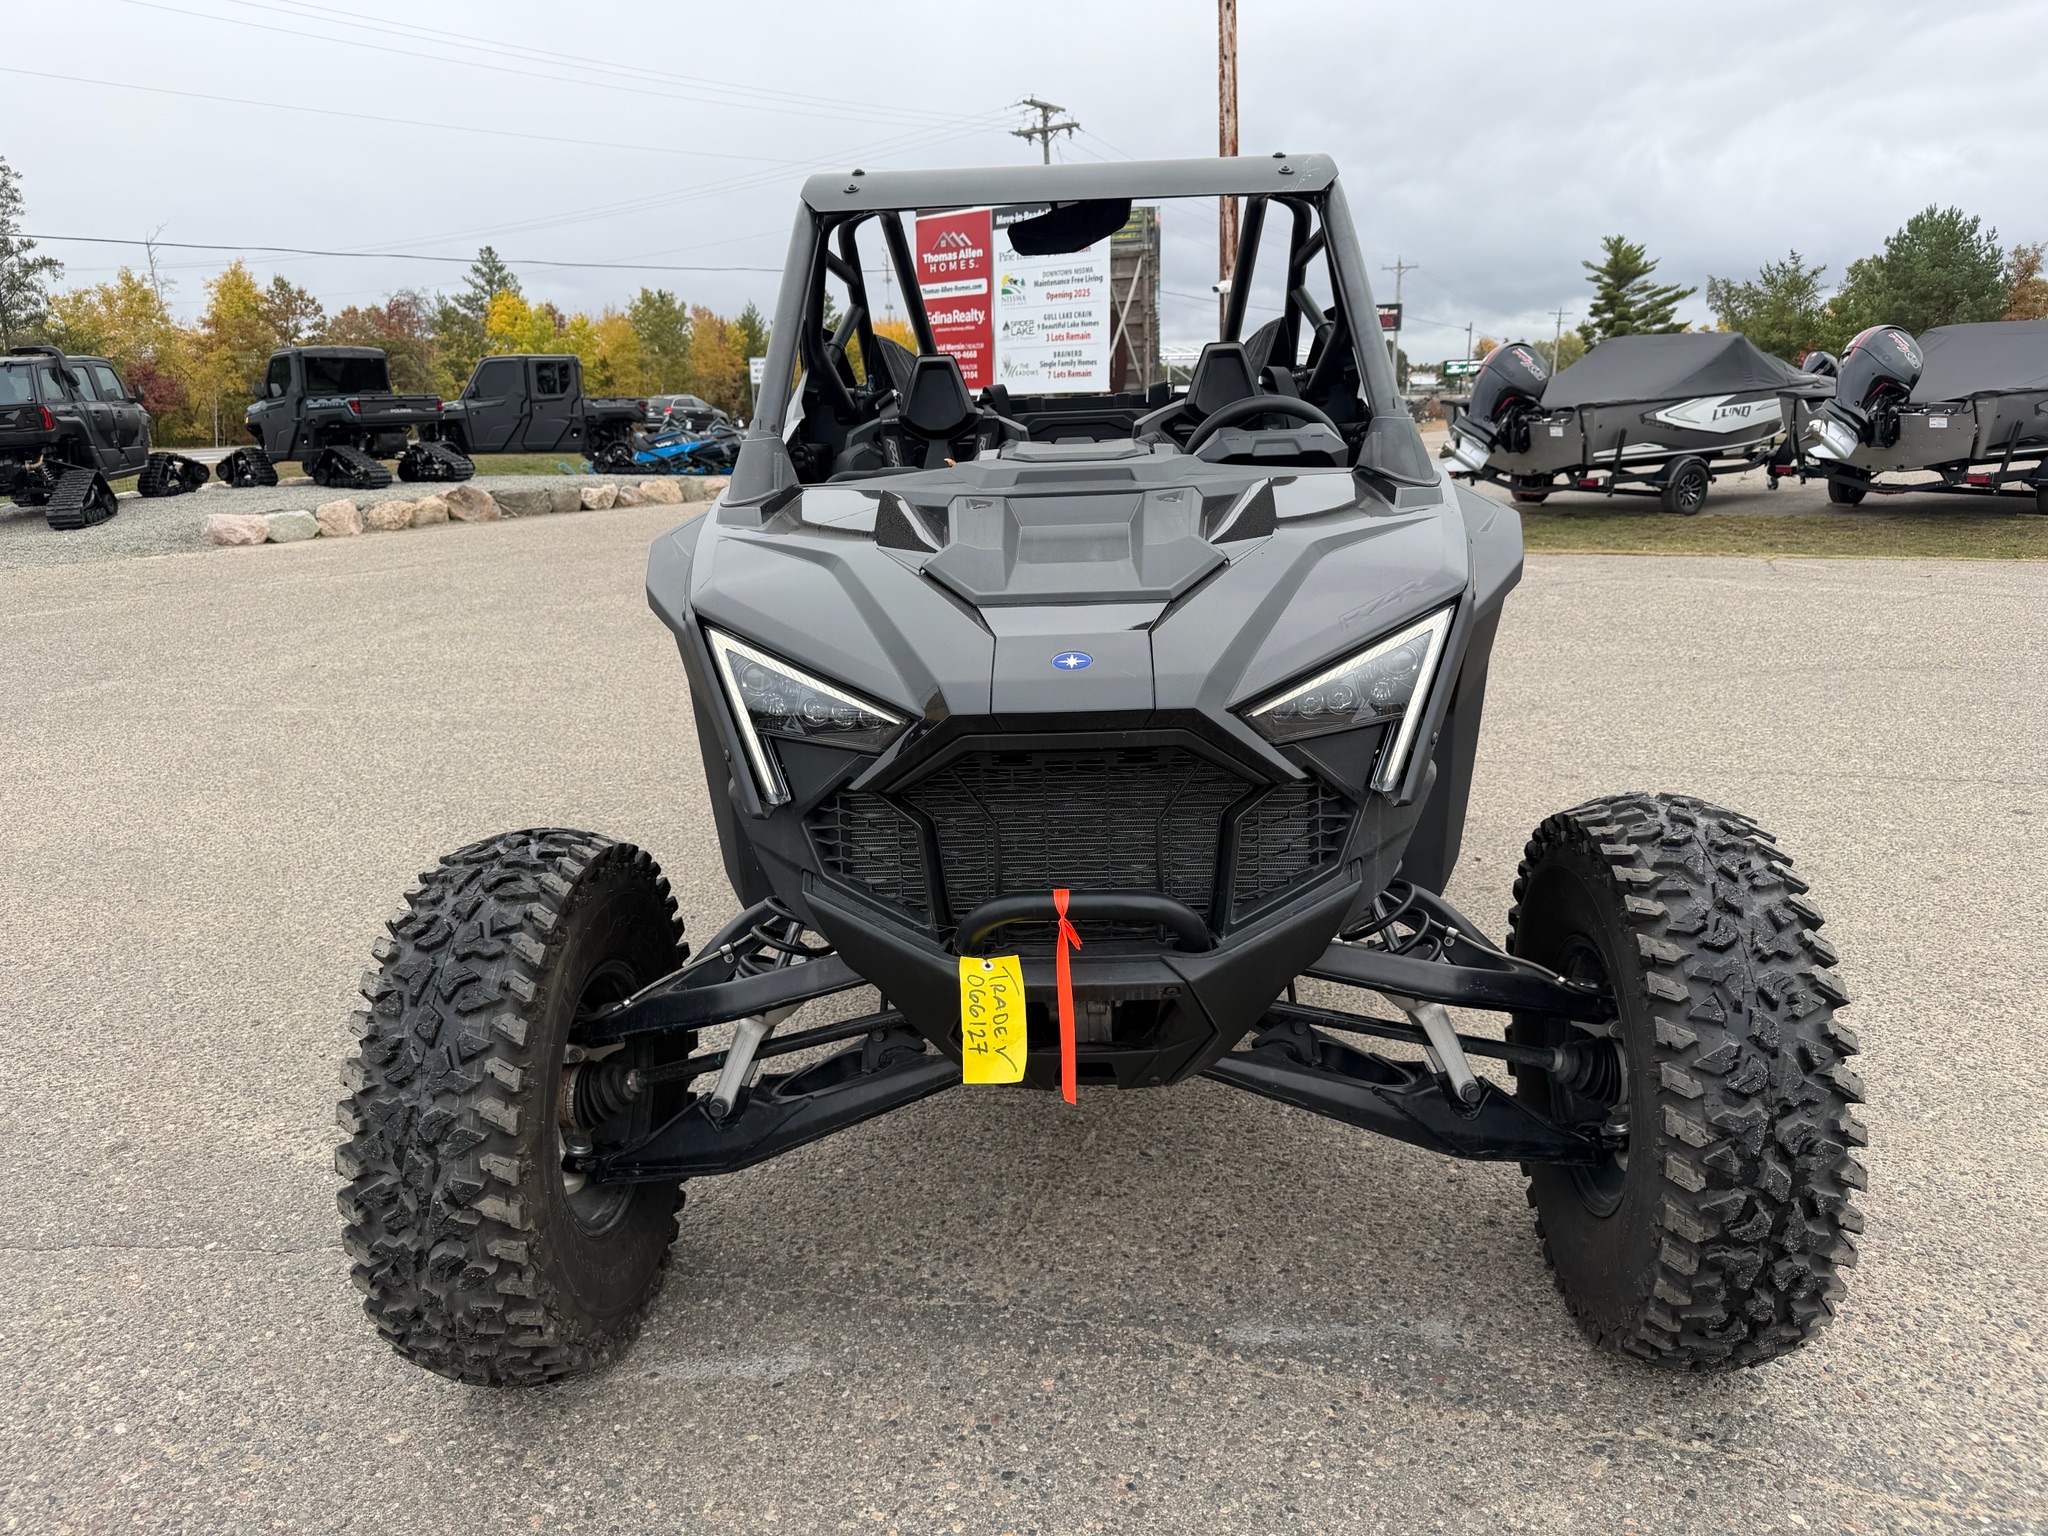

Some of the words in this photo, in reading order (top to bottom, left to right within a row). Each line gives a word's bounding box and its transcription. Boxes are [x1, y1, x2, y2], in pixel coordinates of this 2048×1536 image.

[922, 252, 957, 263] Thomas
[958, 248, 983, 259] Allen
[929, 259, 975, 273] HOMES
[1034, 279, 1070, 287] Maintenance
[1071, 276, 1084, 284] Free
[1085, 275, 1103, 284] Living
[1046, 290, 1073, 301] Opening
[1074, 288, 1090, 298] 2025
[1043, 313, 1057, 321] GULL
[1058, 312, 1072, 320] LAKE
[1073, 311, 1092, 319] CHAIN
[1041, 322, 1066, 330] Beautiful
[1066, 321, 1080, 329] Lake
[1081, 319, 1099, 327] Homes
[1010, 327, 1035, 336] LAKE
[1051, 333, 1064, 341] Lots
[1066, 332, 1091, 341] Remain
[1053, 350, 1082, 358] BRAINERD
[1039, 361, 1057, 369] Single
[1058, 360, 1076, 368] Family
[1077, 359, 1097, 367] Homes
[1053, 370, 1066, 378] Lots
[1068, 369, 1092, 378] Remain
[1711, 405, 1751, 423] LUND
[966, 974, 989, 1056] 066127
